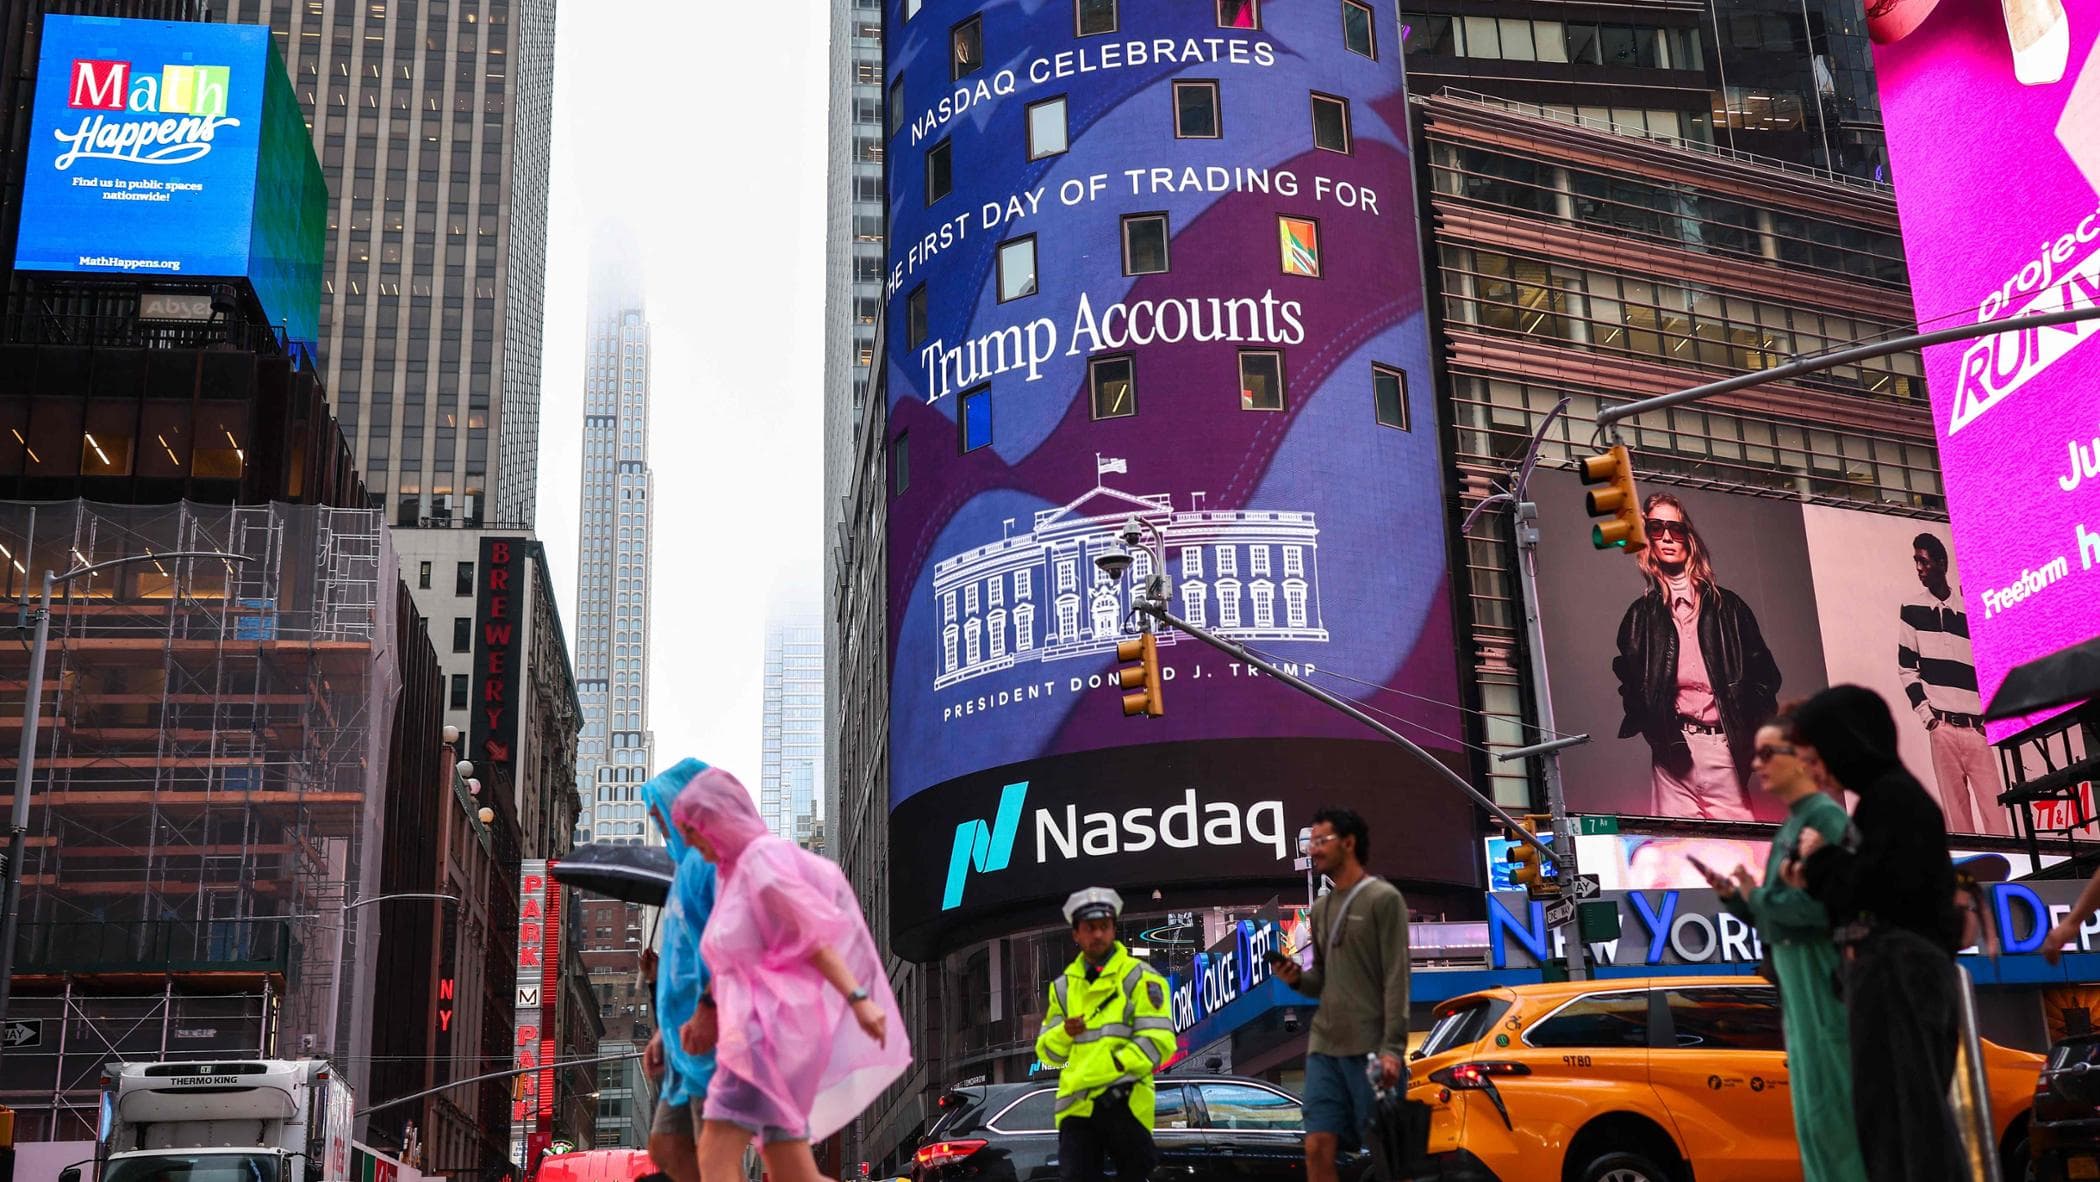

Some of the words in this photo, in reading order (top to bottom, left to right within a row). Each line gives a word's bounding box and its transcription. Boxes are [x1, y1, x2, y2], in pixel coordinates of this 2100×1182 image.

[72, 61, 228, 115] Math
[911, 69, 1015, 146] NASDAQ
[1029, 38, 1275, 84] CELEBRATES
[54, 115, 240, 170] Happens
[72, 177, 97, 187] Find
[100, 179, 113, 188] us
[115, 178, 126, 188] in
[128, 179, 164, 190] public
[165, 181, 203, 192] spaces
[103, 190, 170, 201] nationwide!
[908, 212, 970, 275] FIRST
[983, 187, 1046, 230] DAY
[1060, 173, 1108, 205] OF
[1124, 166, 1298, 197] TRADING
[1315, 176, 1379, 216] FOR
[79, 256, 180, 270] MathHappens.org
[920, 317, 1057, 405] Trump
[1065, 288, 1305, 356] Accounts
[1981, 556, 2069, 619] Freeform
[485, 542, 511, 730] BREWERY
[944, 681, 1055, 722] PRESIDENT
[1070, 666, 1176, 692] DOND
[1193, 664, 1212, 679] J.
[1035, 788, 1287, 863] Nasdaq
[1589, 819, 1596, 833] 7
[520, 875, 543, 968] PARK
[1548, 910, 1558, 922] ONE
[1561, 904, 1571, 917] WAY
[1171, 978, 1196, 1034] ORK
[1193, 951, 1236, 1021] POLICE
[1236, 919, 1273, 993] DEPT
[440, 978, 454, 1032] NY
[170, 1077, 212, 1086] THERMO
[214, 1076, 238, 1084] KING
